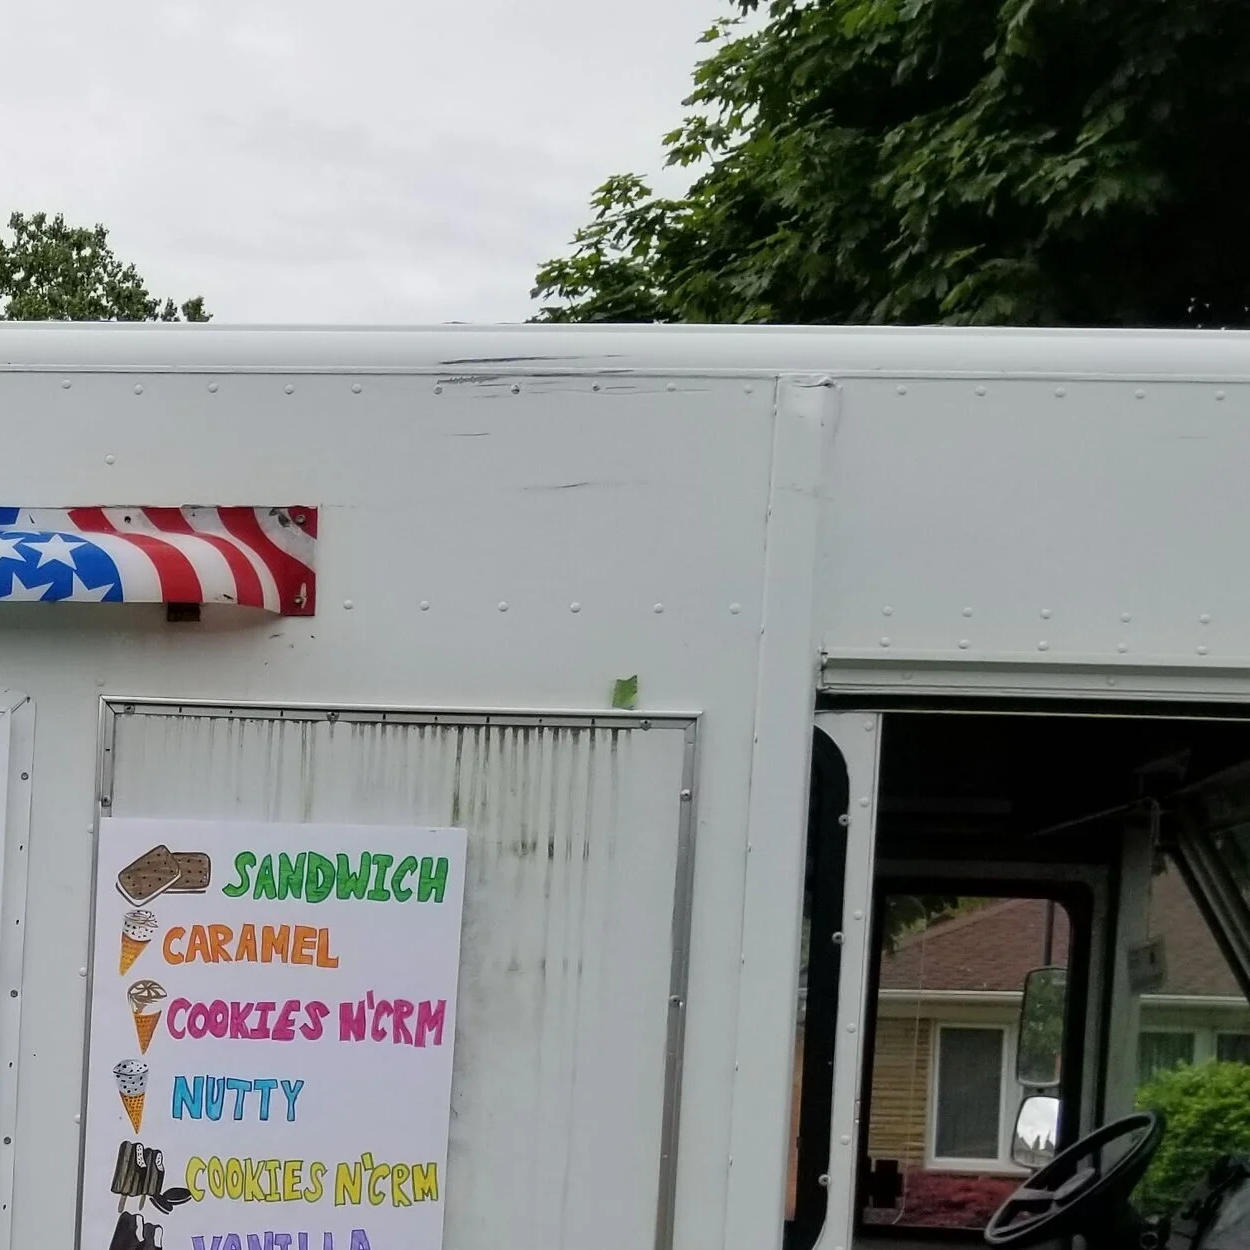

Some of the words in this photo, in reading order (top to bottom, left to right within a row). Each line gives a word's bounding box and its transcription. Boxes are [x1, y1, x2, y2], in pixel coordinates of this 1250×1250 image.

[223, 851, 448, 902] SANDWICH
[162, 924, 339, 968] CARAMEL
[167, 998, 330, 1042] COOKIES
[339, 990, 446, 1047] N'CRM
[172, 1076, 304, 1121] NUTTY
[186, 1157, 328, 1203] COOKIES
[335, 1152, 439, 1207] N'CRM
